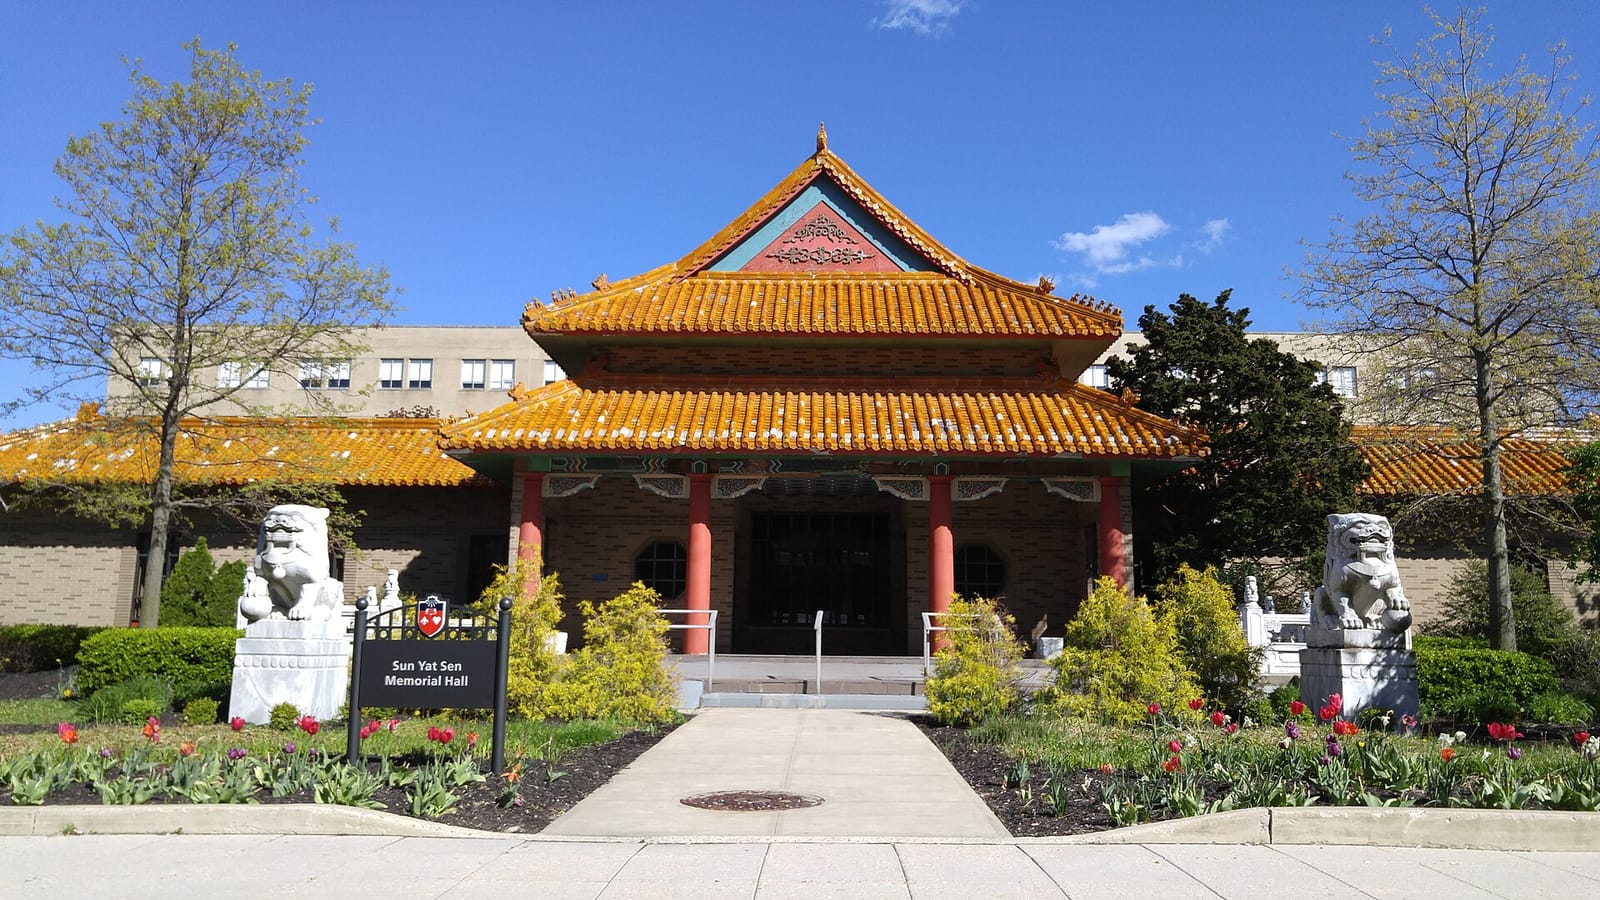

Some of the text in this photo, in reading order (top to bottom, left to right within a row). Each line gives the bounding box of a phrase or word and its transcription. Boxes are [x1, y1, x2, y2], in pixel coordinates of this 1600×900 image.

[392, 660, 462, 672] Sun Yat Sen
[384, 675, 469, 687] Memorial Hall
